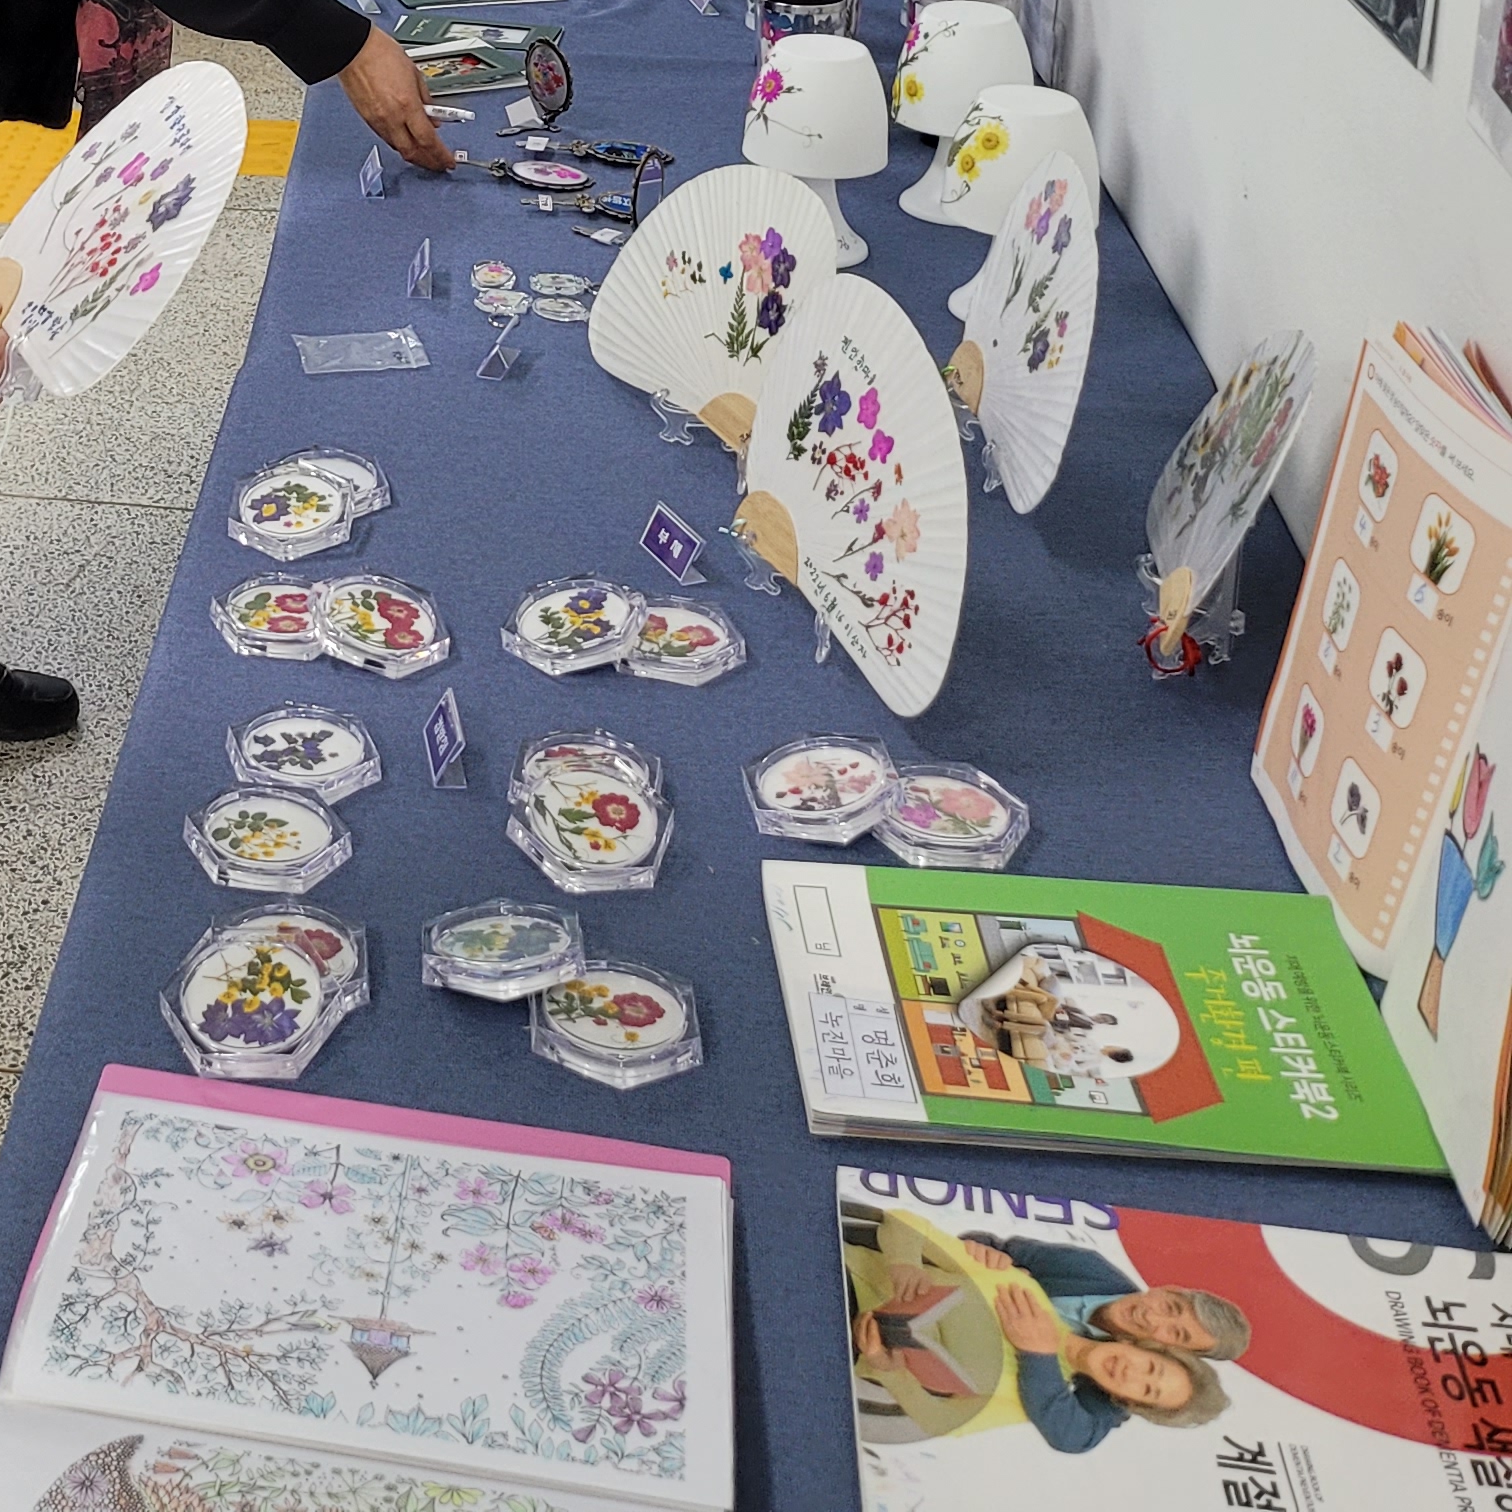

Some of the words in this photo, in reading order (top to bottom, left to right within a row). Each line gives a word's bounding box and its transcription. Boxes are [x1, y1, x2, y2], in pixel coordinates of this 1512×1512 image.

[656, 527, 682, 558] 부채
[1414, 582, 1428, 605] 6
[1226, 931, 1289, 1002] 뇌운동
[1183, 964, 1259, 1052] 주거환경
[817, 1011, 855, 1080] 녹진마을
[860, 1029, 906, 1089] 명춘희
[1220, 1057, 1273, 1081] 편
[1256, 1006, 1339, 1121] 스티커북2
[1385, 1290, 1418, 1355] DRAWING
[1421, 1295, 1504, 1409] 뇌운동
[1405, 1354, 1433, 1393] BOOK
[1421, 1392, 1442, 1421] OF
[1427, 1417, 1469, 1493] DEMENTIA
